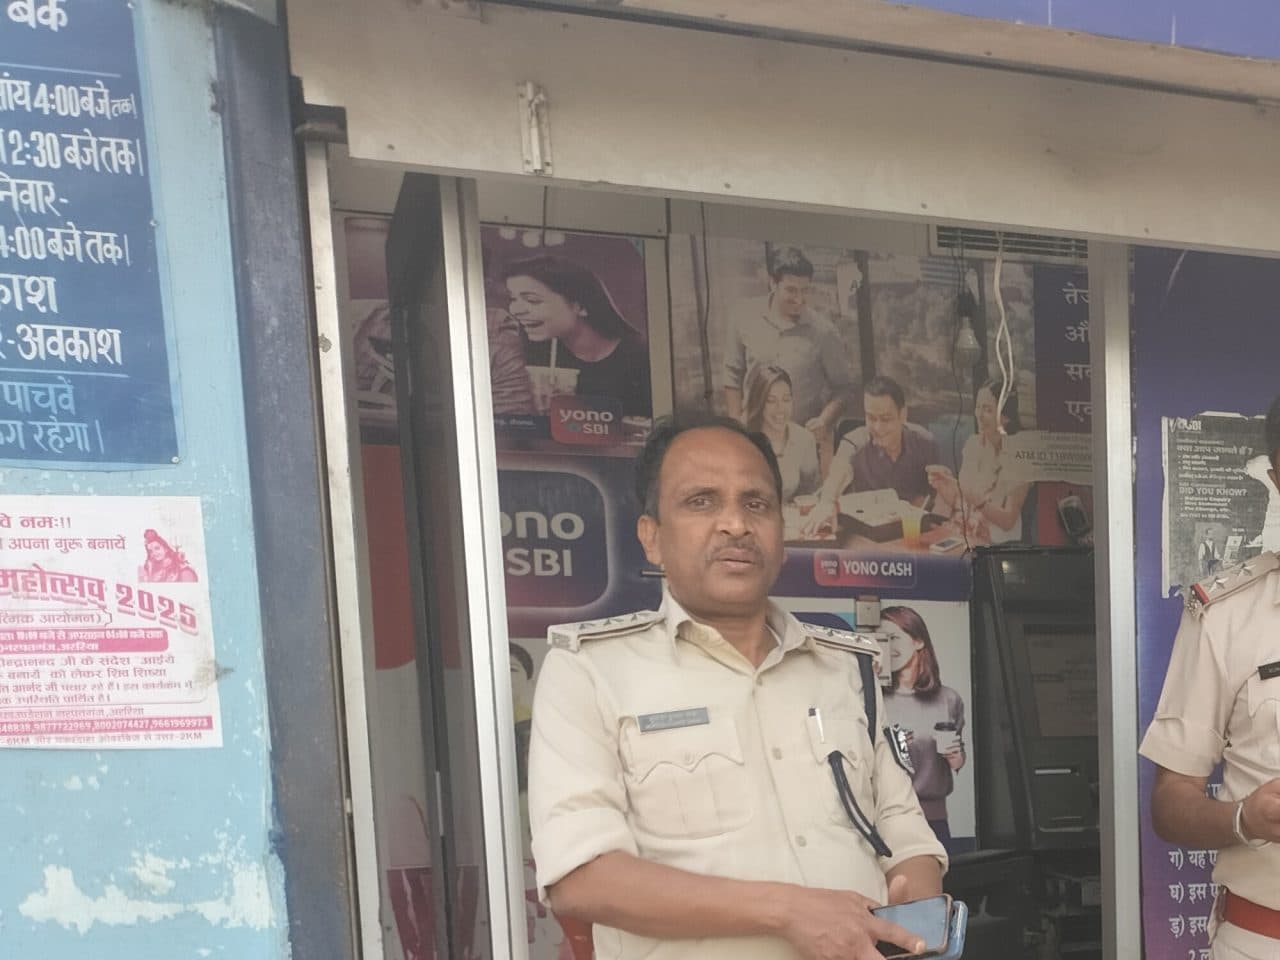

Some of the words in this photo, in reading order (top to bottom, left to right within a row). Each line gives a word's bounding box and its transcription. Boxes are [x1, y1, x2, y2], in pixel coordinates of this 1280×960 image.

[559, 408, 614, 423] yono
[582, 423, 609, 435] SBI
[8, 537, 50, 550] अपना
[506, 547, 573, 577] SBI
[843, 560, 878, 575] YONO
[881, 561, 912, 577] CASH
[1188, 850, 1206, 869] यह
[1188, 882, 1206, 904] इस
[1188, 916, 1206, 940] इस
